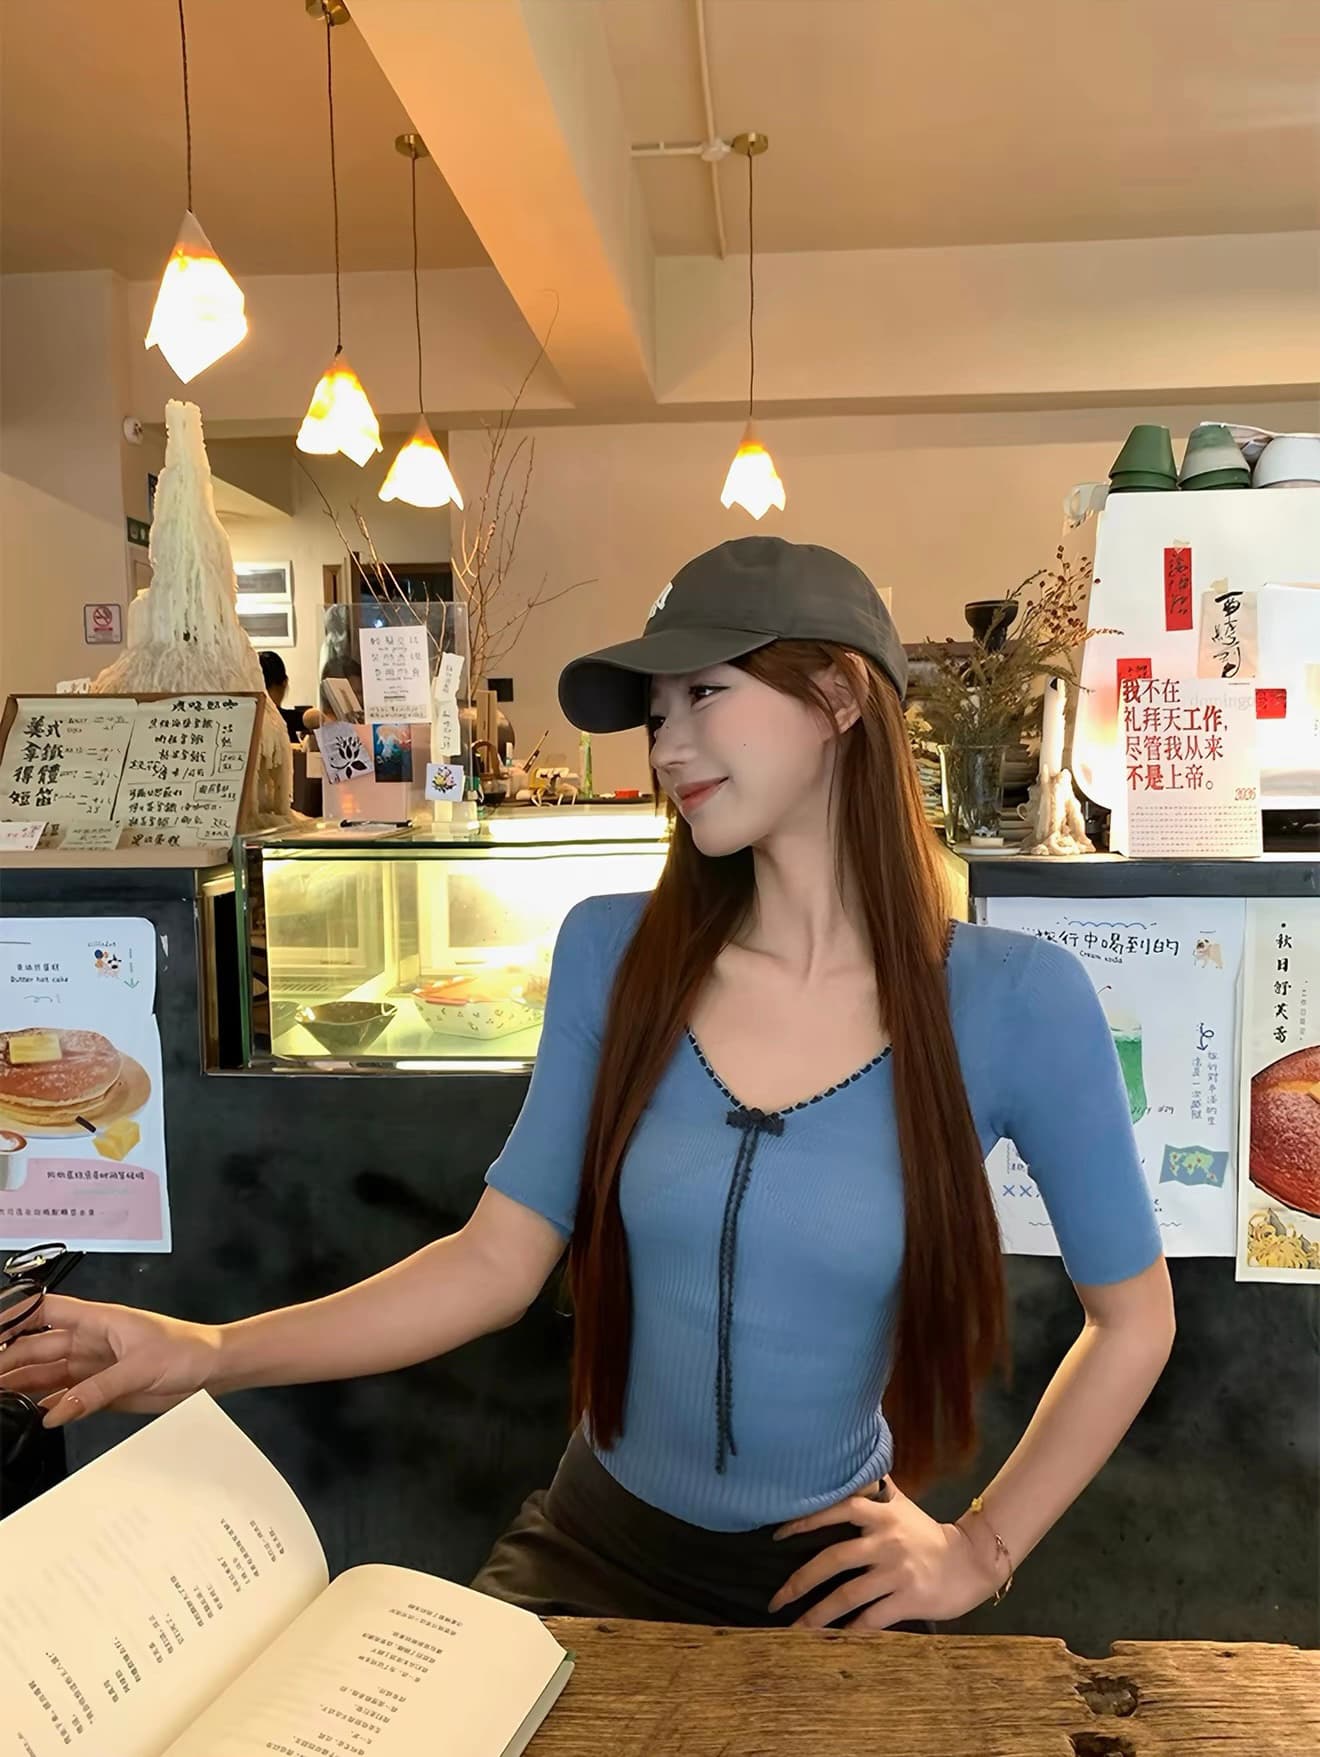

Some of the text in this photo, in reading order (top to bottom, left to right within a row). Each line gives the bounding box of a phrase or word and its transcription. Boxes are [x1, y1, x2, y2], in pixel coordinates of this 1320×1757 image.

[1122, 679, 1181, 704] 我不在
[23, 716, 64, 739] 美式
[20, 740, 65, 763] 拿鐵
[1126, 735, 1224, 761] 尽管我从来
[1127, 764, 1214, 791] 不是上帝。
[10, 975, 33, 983] Butter
[52, 975, 69, 983] cake
